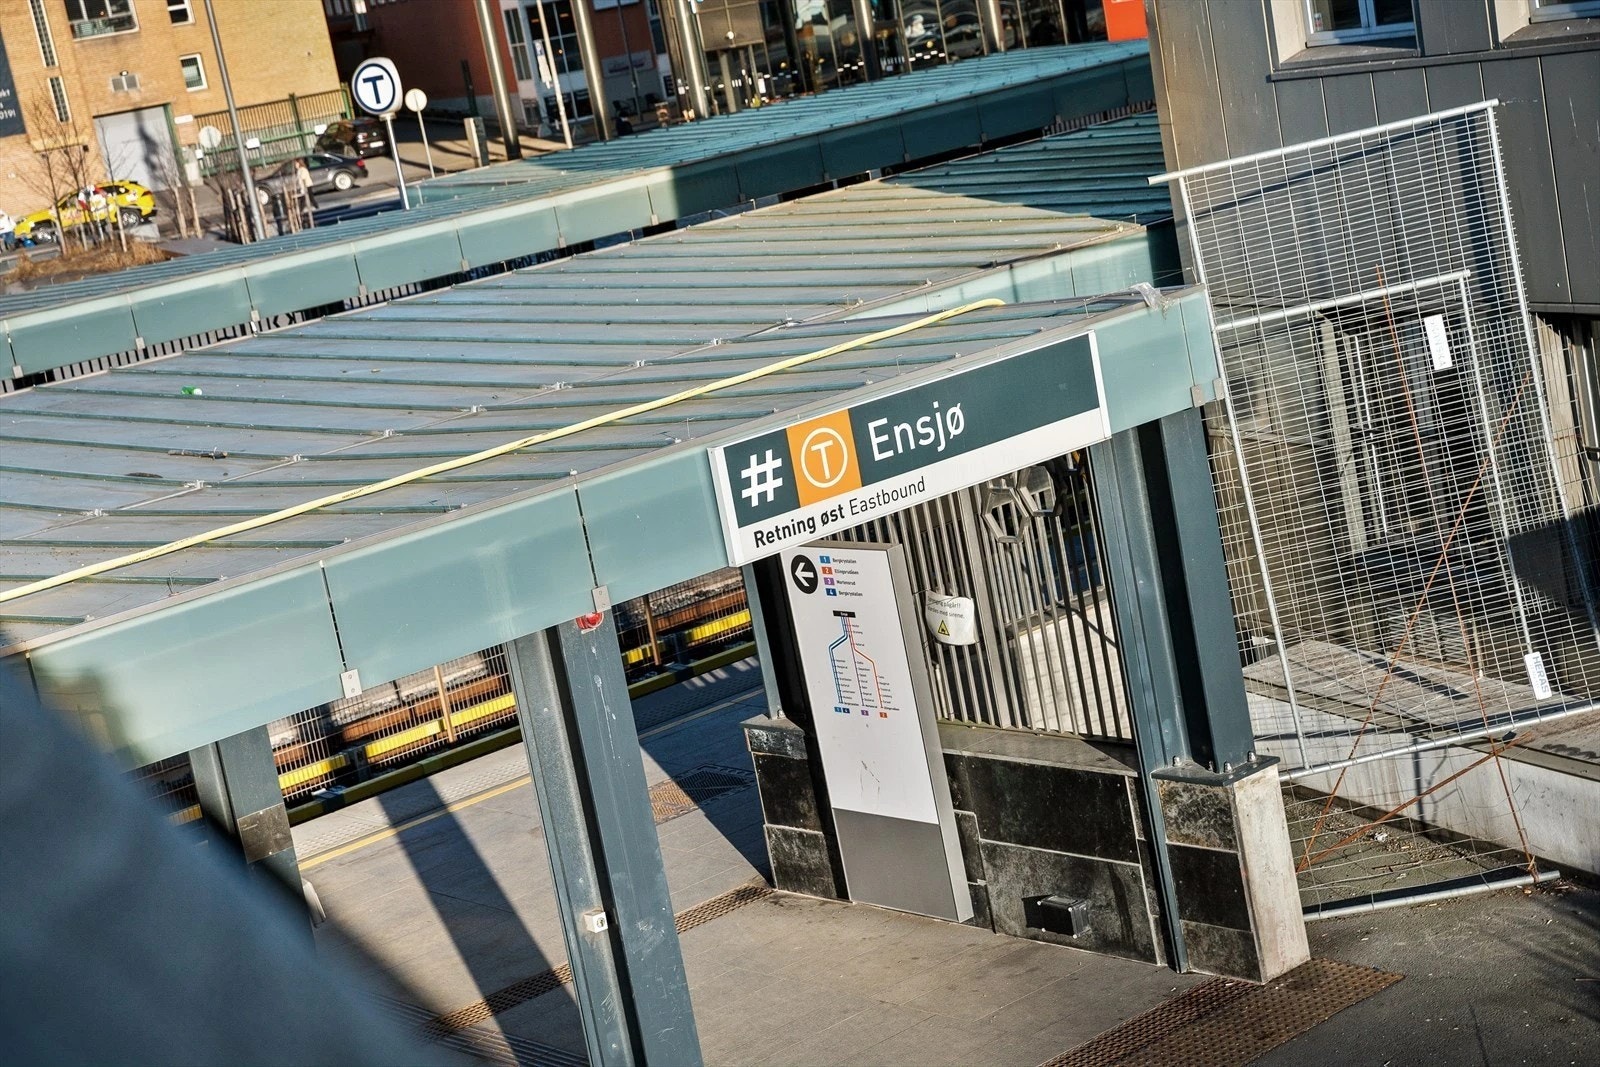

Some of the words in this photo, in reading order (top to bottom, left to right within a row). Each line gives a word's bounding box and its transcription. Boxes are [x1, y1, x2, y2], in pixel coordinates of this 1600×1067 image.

[362, 75, 384, 104] T
[868, 400, 965, 462] Ensjø
[753, 514, 816, 548] Retning
[821, 504, 845, 527] øst
[849, 475, 926, 516] Eastbound
[1532, 656, 1550, 693] HERAS
